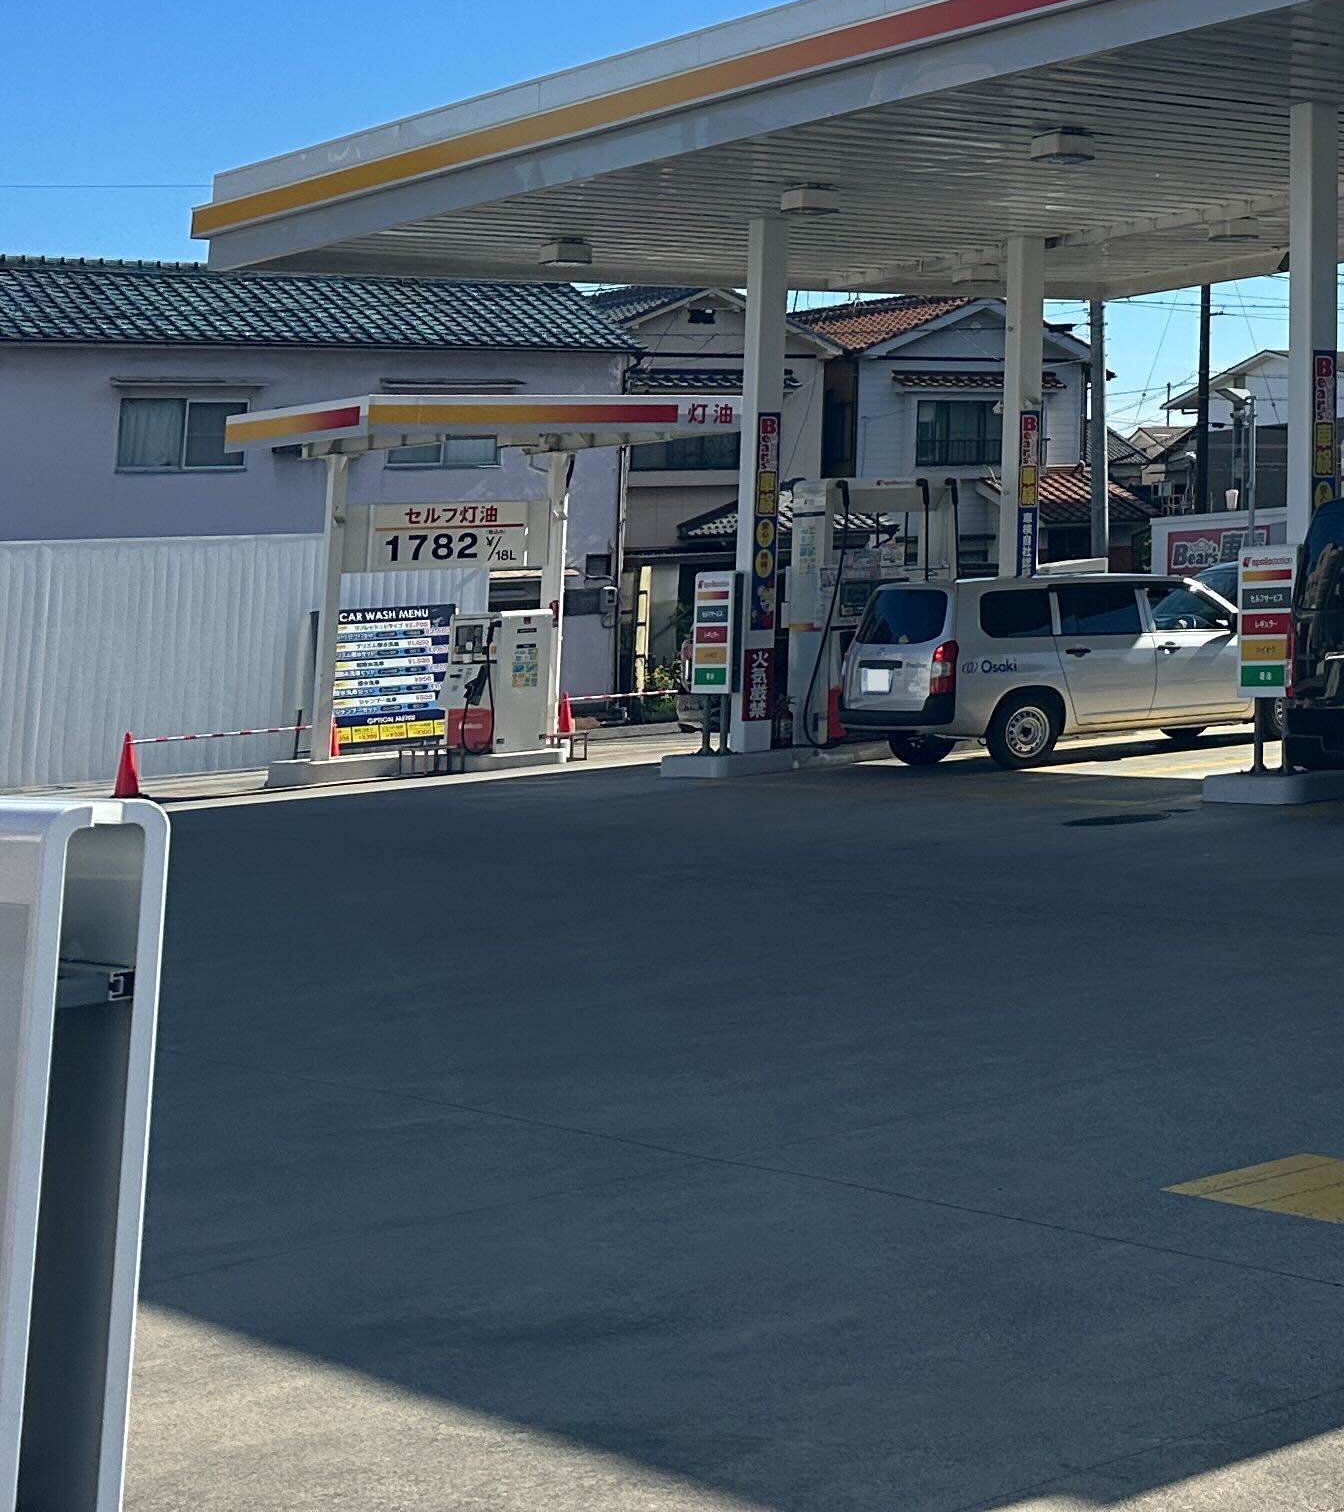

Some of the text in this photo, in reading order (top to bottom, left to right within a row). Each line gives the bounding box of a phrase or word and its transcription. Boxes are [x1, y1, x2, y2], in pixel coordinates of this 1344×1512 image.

[688, 404, 733, 424] 灯油
[405, 506, 498, 524] セルフ灯油
[386, 533, 478, 561] 1782
[339, 608, 429, 622] CAR WASH MENU
[981, 659, 1018, 674] Osaki
[749, 650, 769, 719] 火気厳禁
